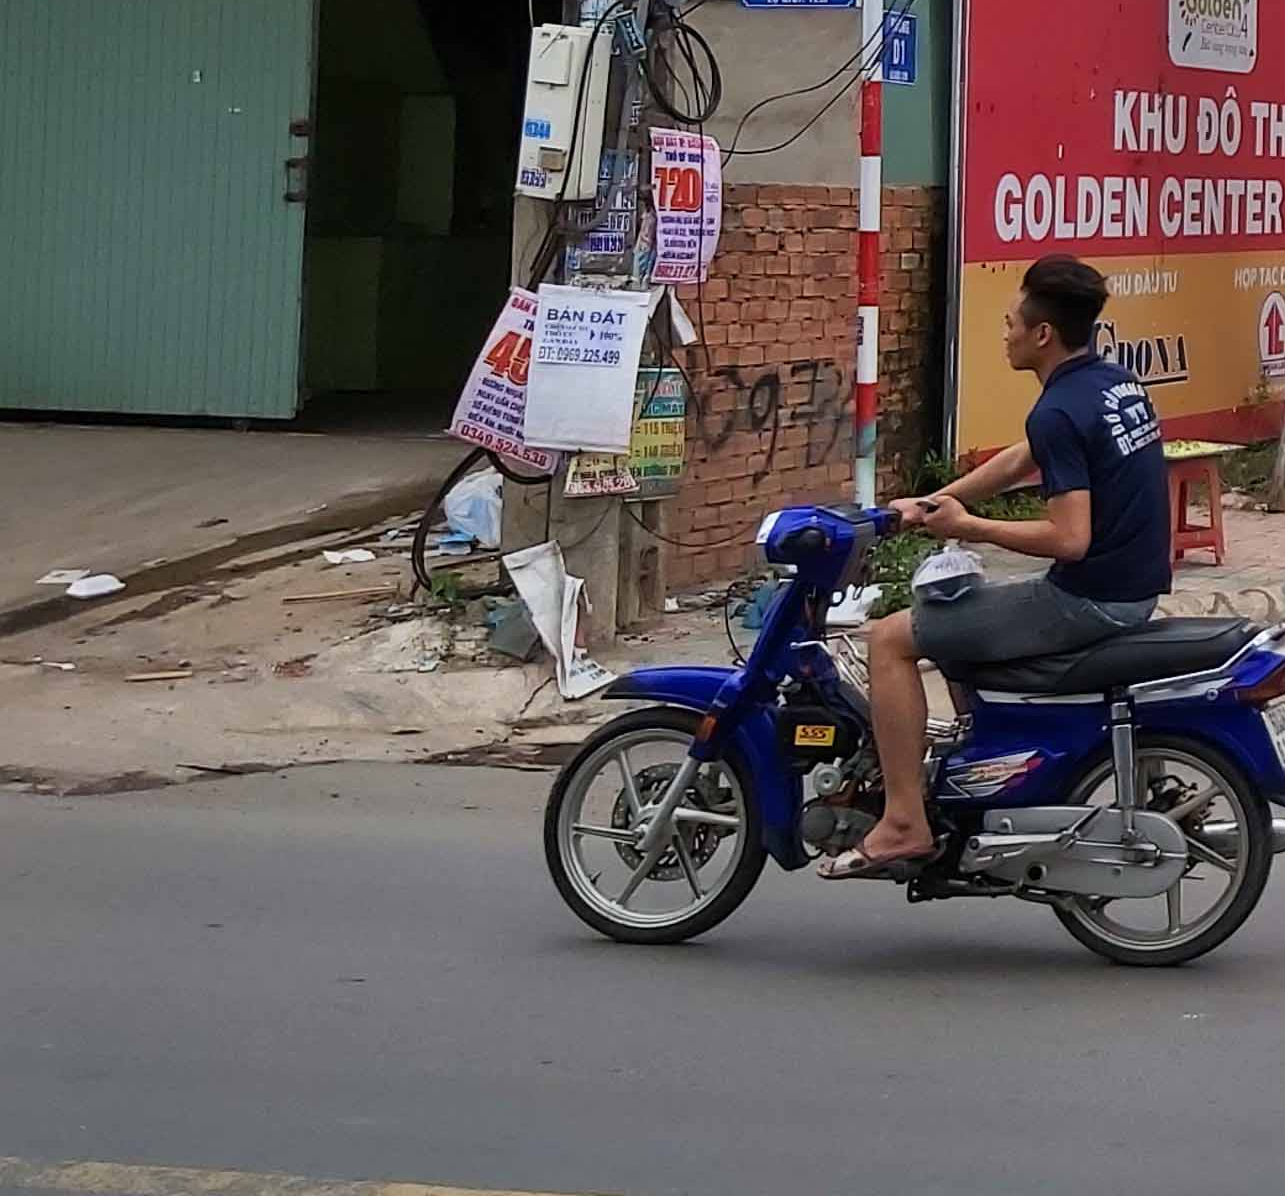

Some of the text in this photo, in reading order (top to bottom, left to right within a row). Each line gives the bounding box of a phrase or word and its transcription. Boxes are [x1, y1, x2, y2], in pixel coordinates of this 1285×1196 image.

[1113, 89, 1188, 156] KHU
[1196, 85, 1242, 157] ĐÔ
[654, 167, 703, 213] 720
[994, 172, 1284, 242] GOLDEN CENTER
[547, 305, 628, 325] BÁN ĐẤT
